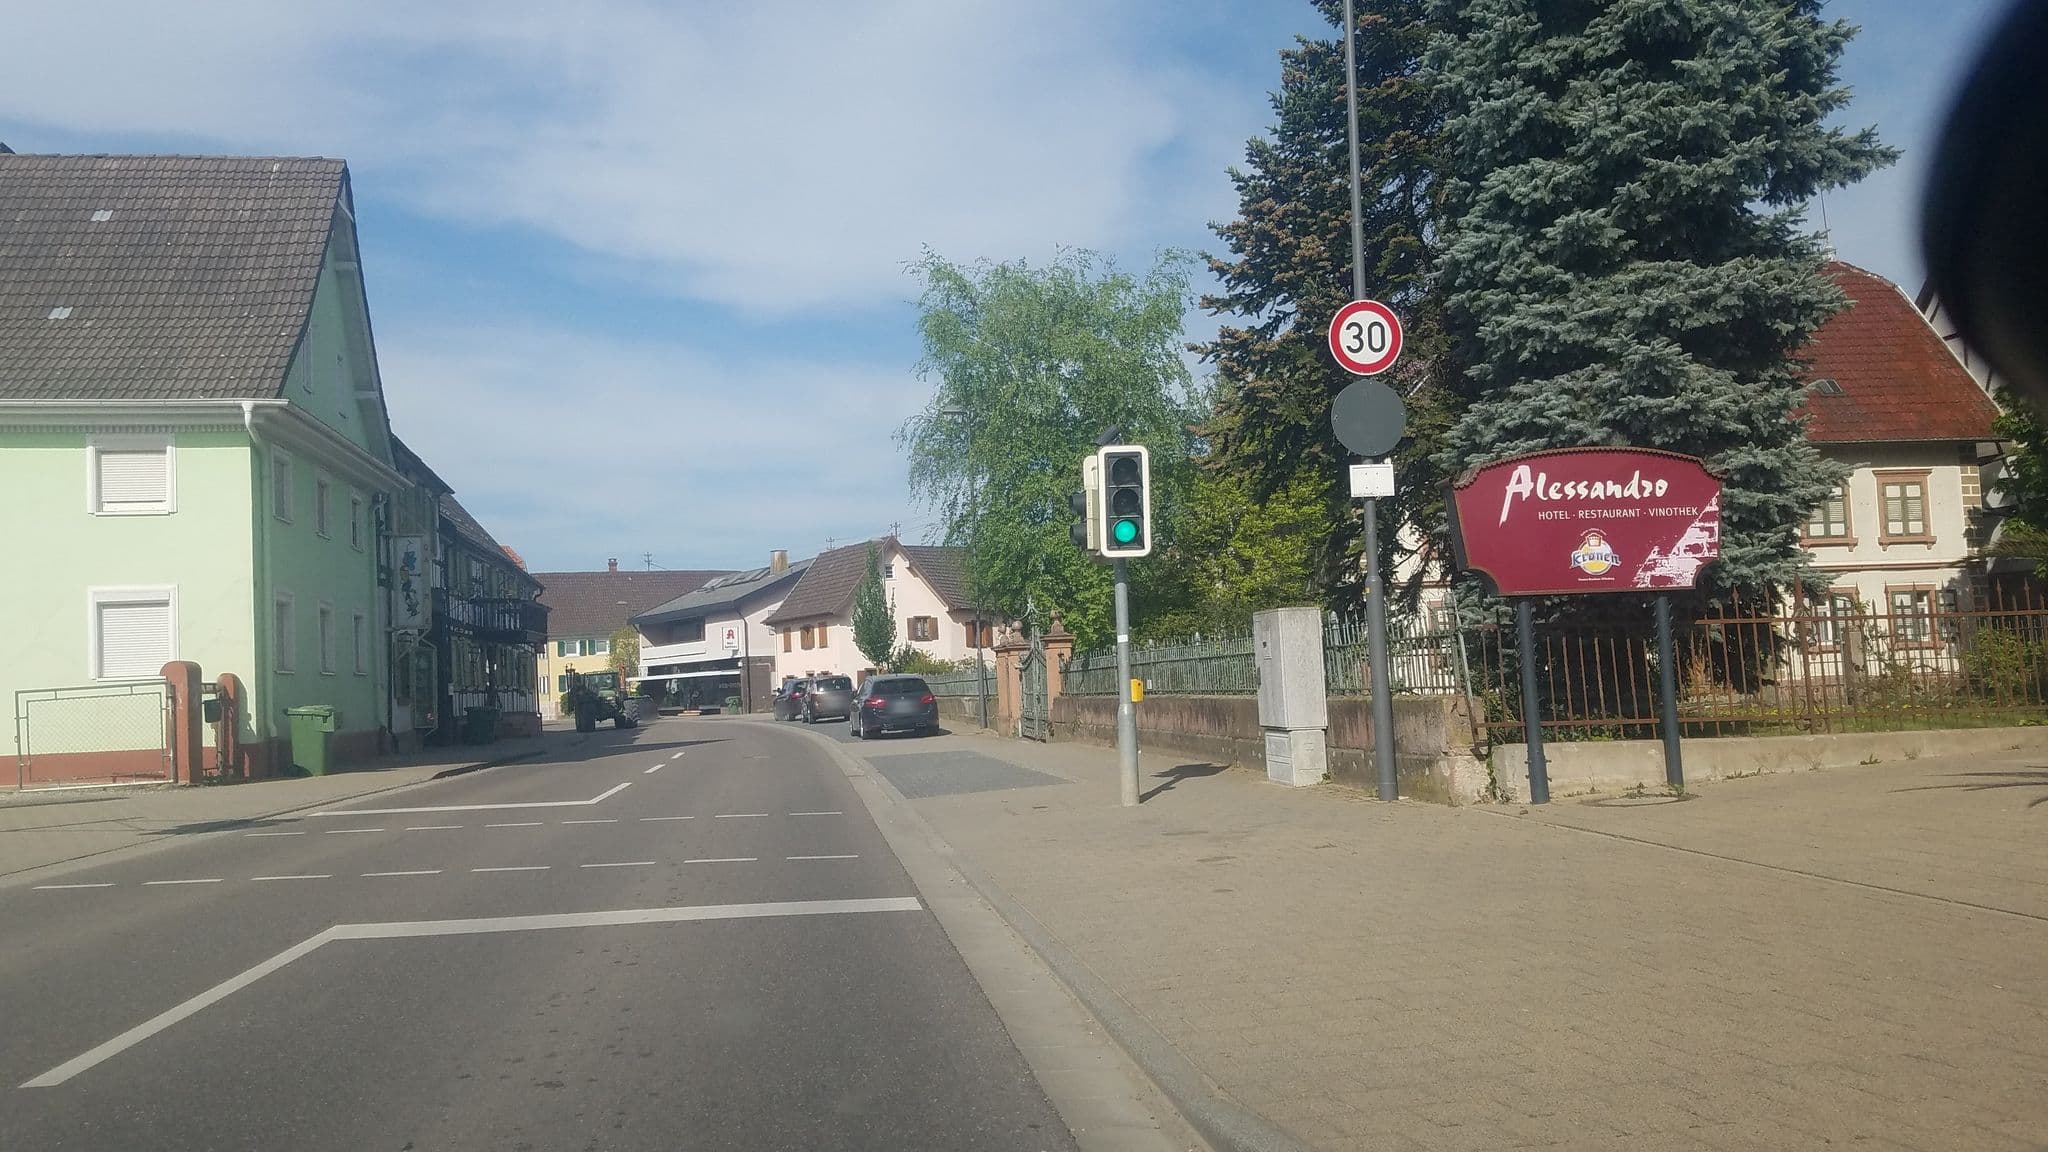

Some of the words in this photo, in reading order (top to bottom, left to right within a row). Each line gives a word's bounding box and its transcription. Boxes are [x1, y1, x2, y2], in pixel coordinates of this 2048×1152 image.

[1345, 321, 1386, 354] 30
[1499, 465, 1668, 528] Alessandro
[1538, 508, 1571, 521] HOTEL
[1578, 507, 1641, 519] RESTAURANT
[1649, 506, 1699, 518] VINOTHEK
